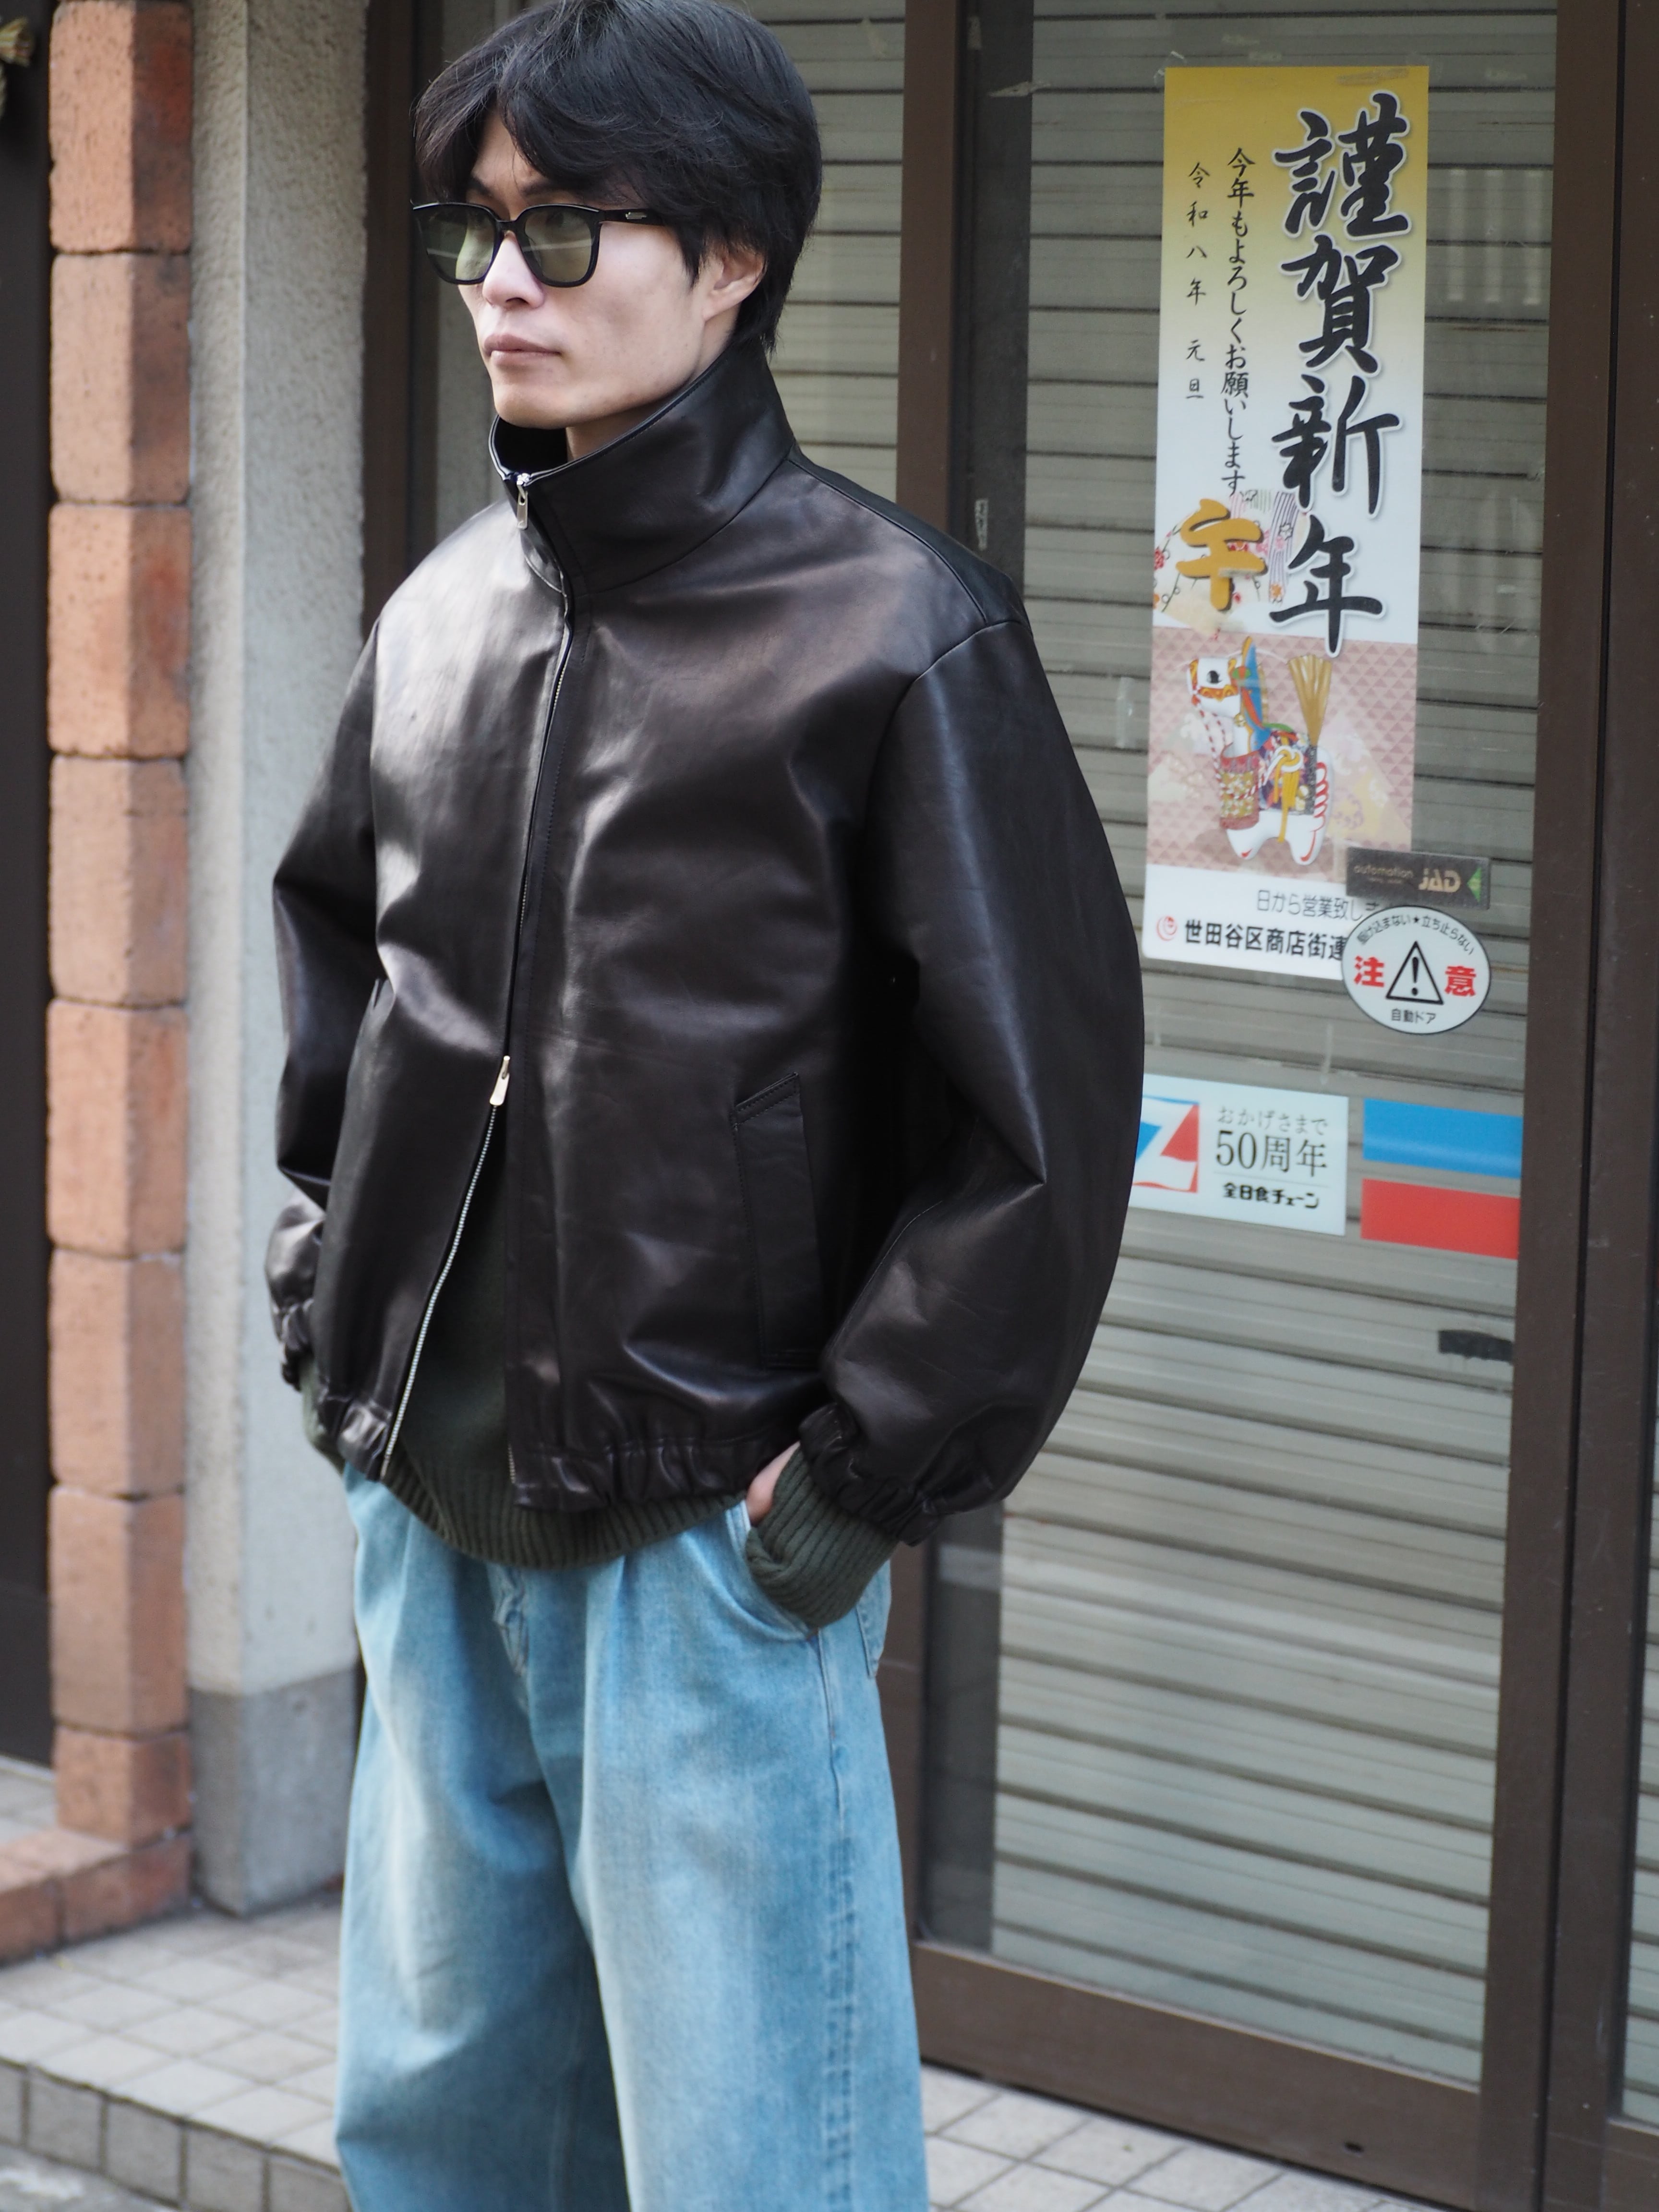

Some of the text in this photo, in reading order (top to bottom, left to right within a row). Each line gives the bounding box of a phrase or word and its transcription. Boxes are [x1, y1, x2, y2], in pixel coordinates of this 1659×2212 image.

[1185, 161, 1210, 399] 令和八年 元旦
[1220, 147, 1255, 497] 今年もよろしくお願いします
[1269, 93, 1409, 653] 謹賀新年
[1185, 919, 1346, 960] 世田谷区商店街連
[1391, 1008, 1436, 1024] 自動ドア
[1217, 1106, 1328, 1135] おかげさまで
[1216, 1130, 1327, 1177] 50周年
[1223, 1182, 1319, 1209] 全日食チェーン
